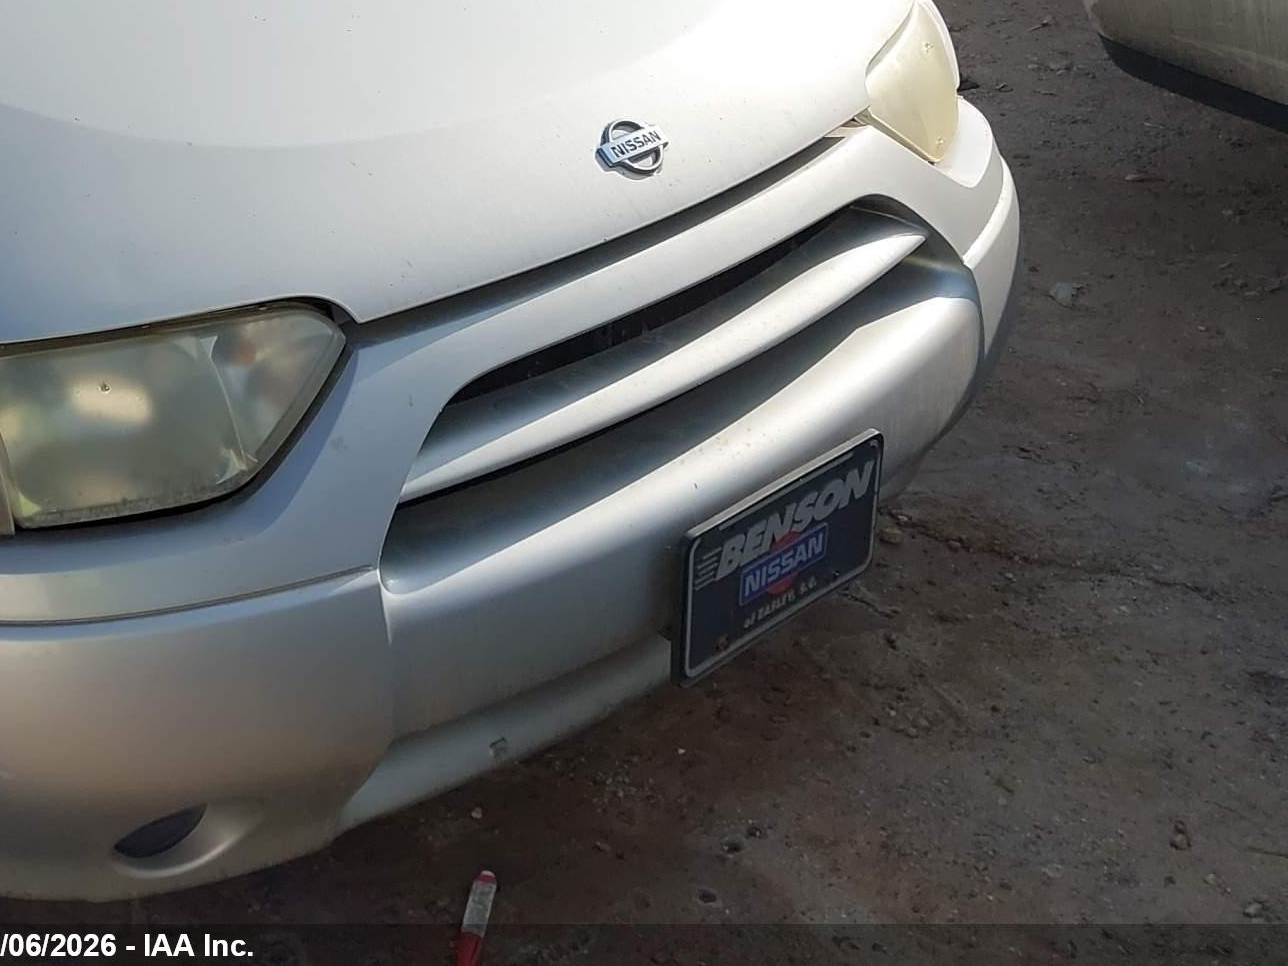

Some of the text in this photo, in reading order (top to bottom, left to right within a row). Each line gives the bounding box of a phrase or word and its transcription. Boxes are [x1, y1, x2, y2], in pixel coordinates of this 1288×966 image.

[610, 129, 663, 158] NISSAN
[714, 459, 876, 582] BENSON
[744, 532, 824, 599] NISSAN
